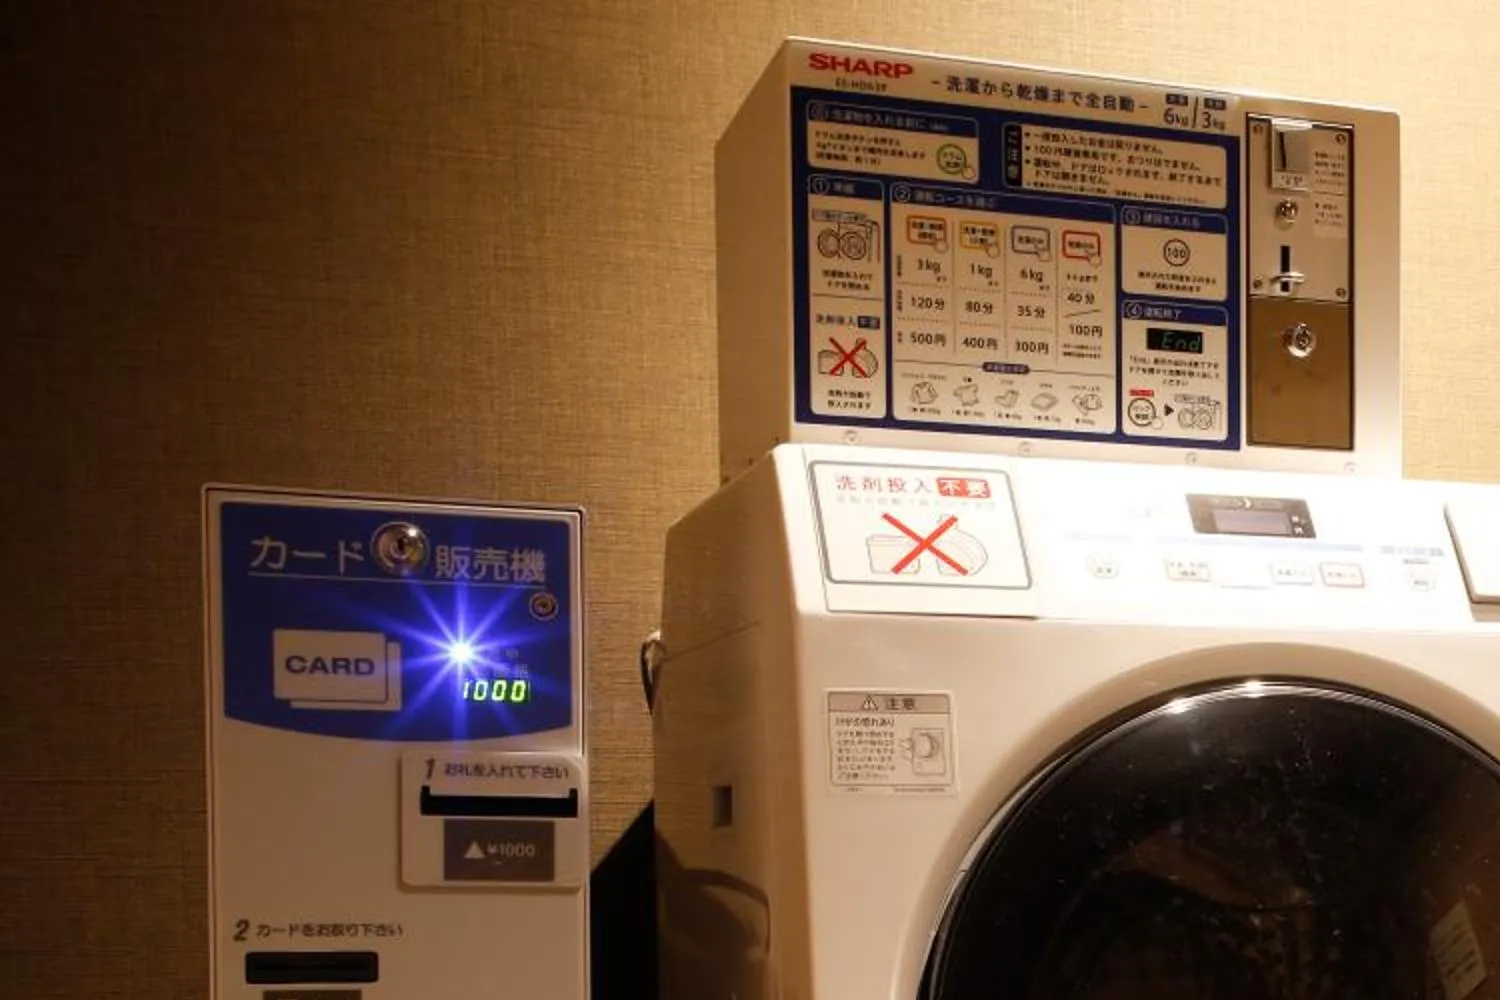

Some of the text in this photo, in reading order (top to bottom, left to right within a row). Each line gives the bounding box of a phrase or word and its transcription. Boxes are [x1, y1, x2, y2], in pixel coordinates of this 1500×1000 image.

[808, 53, 914, 79] SHARP
[909, 332, 947, 347] 500円
[250, 535, 546, 584] カード 販売機
[284, 654, 376, 677] CARD
[463, 679, 526, 701] 1000
